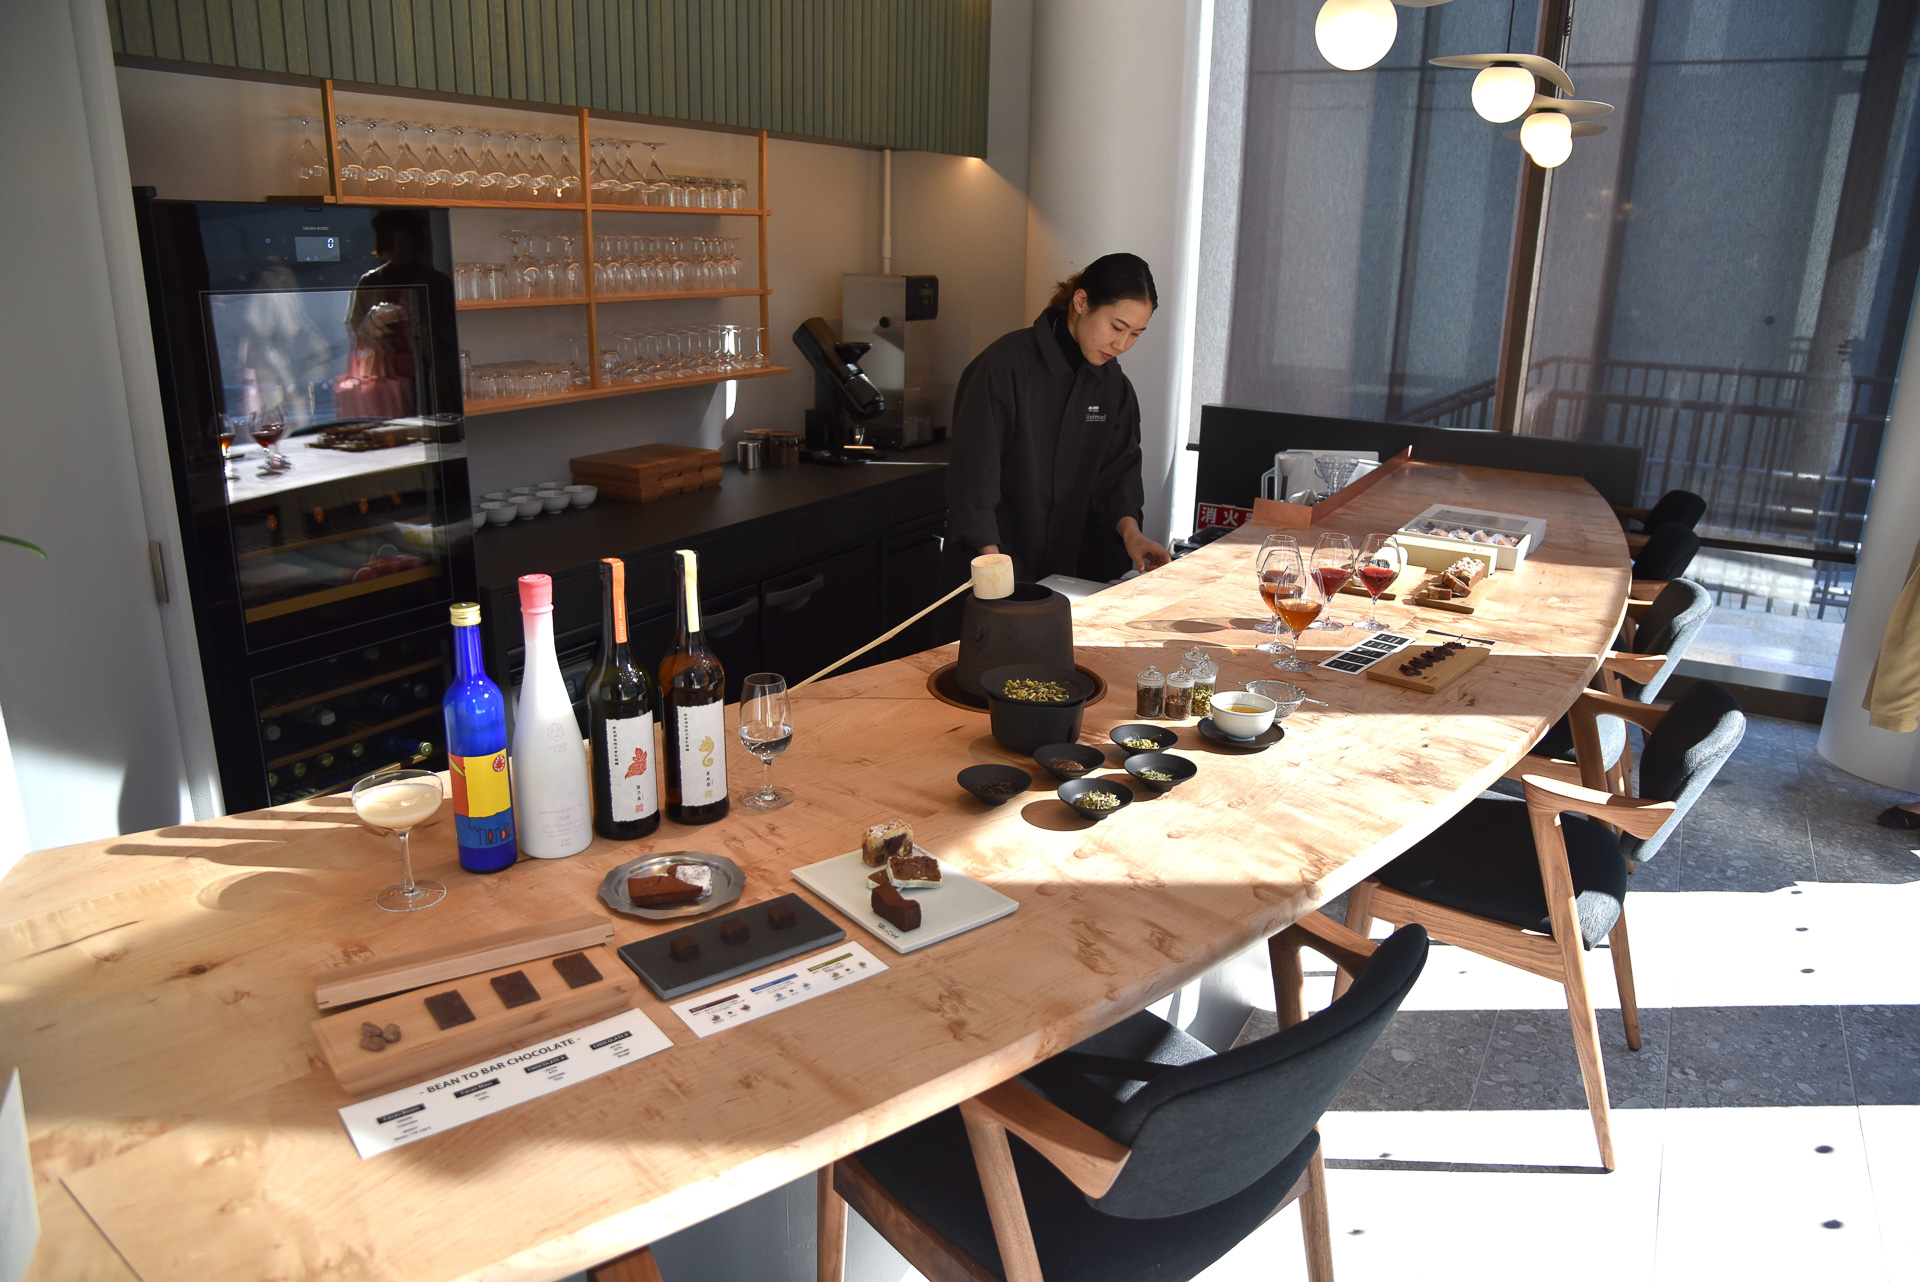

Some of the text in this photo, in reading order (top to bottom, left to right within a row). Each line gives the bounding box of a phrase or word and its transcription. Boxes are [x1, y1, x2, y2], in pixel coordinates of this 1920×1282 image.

[593, 1034, 624, 1048] CHOCOLATE
[427, 1038, 575, 1093] BEAN TO BAR CHOCOLATE
[528, 1057, 560, 1072] CHOCOLATE
